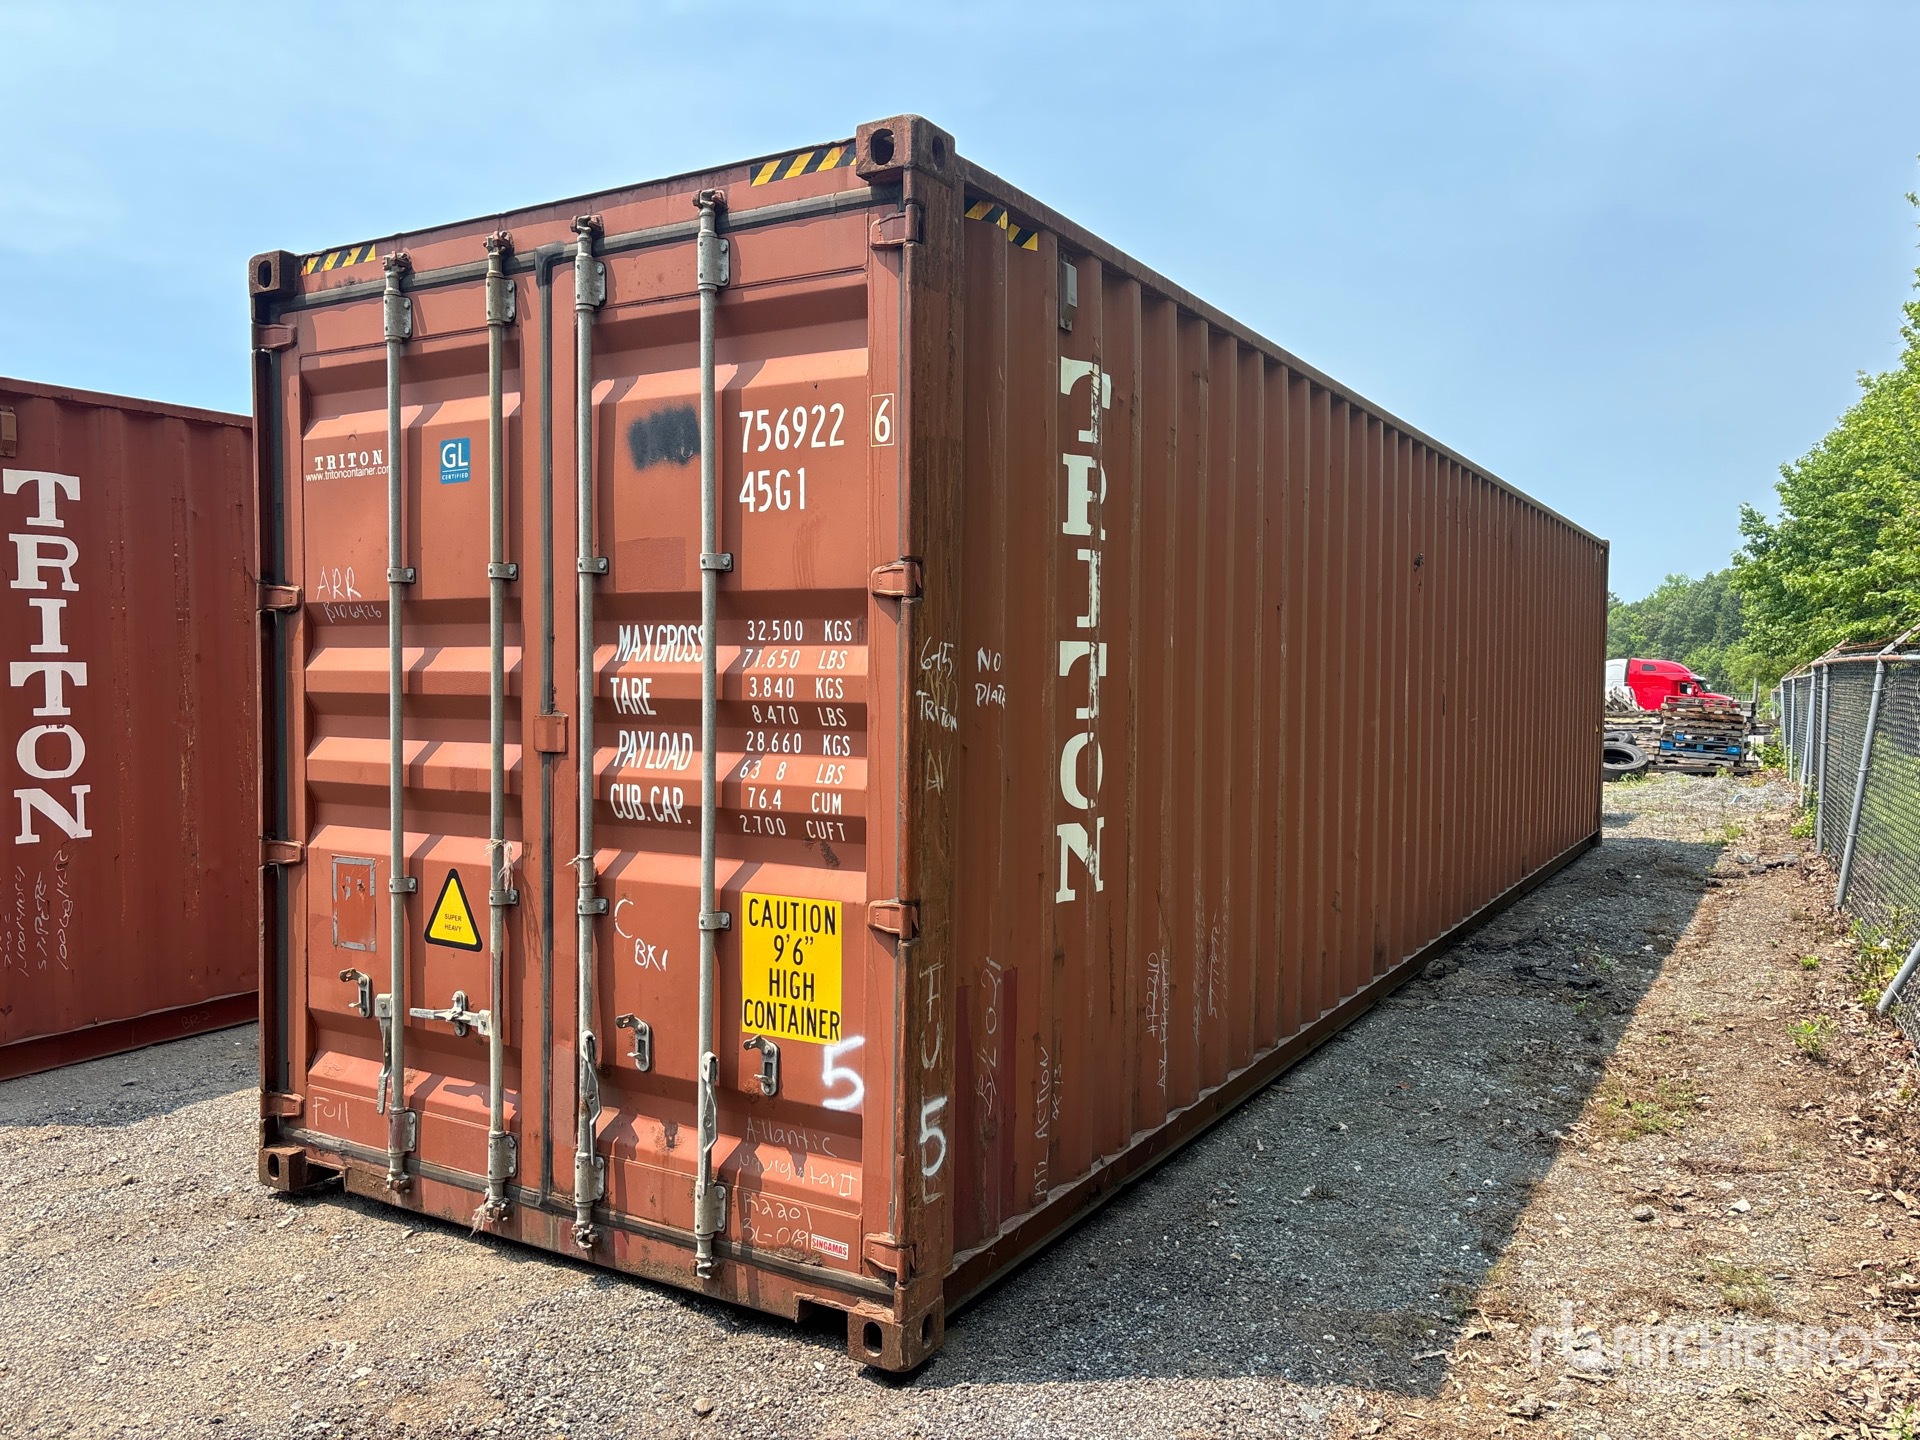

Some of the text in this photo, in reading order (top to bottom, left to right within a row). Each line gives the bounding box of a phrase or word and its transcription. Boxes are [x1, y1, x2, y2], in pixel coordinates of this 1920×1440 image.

[739, 398, 891, 453] 756922 6
[314, 449, 383, 471] TRITON
[441, 443, 469, 469] GL
[441, 471, 469, 481] CERTIFIED
[739, 467, 806, 512] 45G1
[316, 566, 361, 602] ARR
[614, 624, 654, 662] MAX
[824, 620, 852, 642] KGS
[1056, 356, 1111, 903] TRITON
[3, 468, 92, 844] TRITON
[818, 649, 848, 670] LBS
[610, 677, 657, 715] TARE
[815, 677, 844, 699] KGS
[818, 707, 847, 727] LBS
[614, 730, 693, 771] PAYLOAD
[823, 734, 851, 757] KGS
[816, 763, 846, 785] LBS
[748, 787, 782, 810] 76.4
[811, 792, 842, 815] CUM
[806, 820, 846, 842] CUFT
[444, 913, 462, 922] SUPER
[444, 923, 462, 933] HEAVY
[748, 898, 836, 936] CAUTION
[769, 968, 815, 1002] HIGH
[743, 999, 840, 1042] CONTAINER
[822, 1036, 866, 1111] 5
[919, 1096, 949, 1177] 5
[811, 1238, 848, 1257] SINGAMAS
